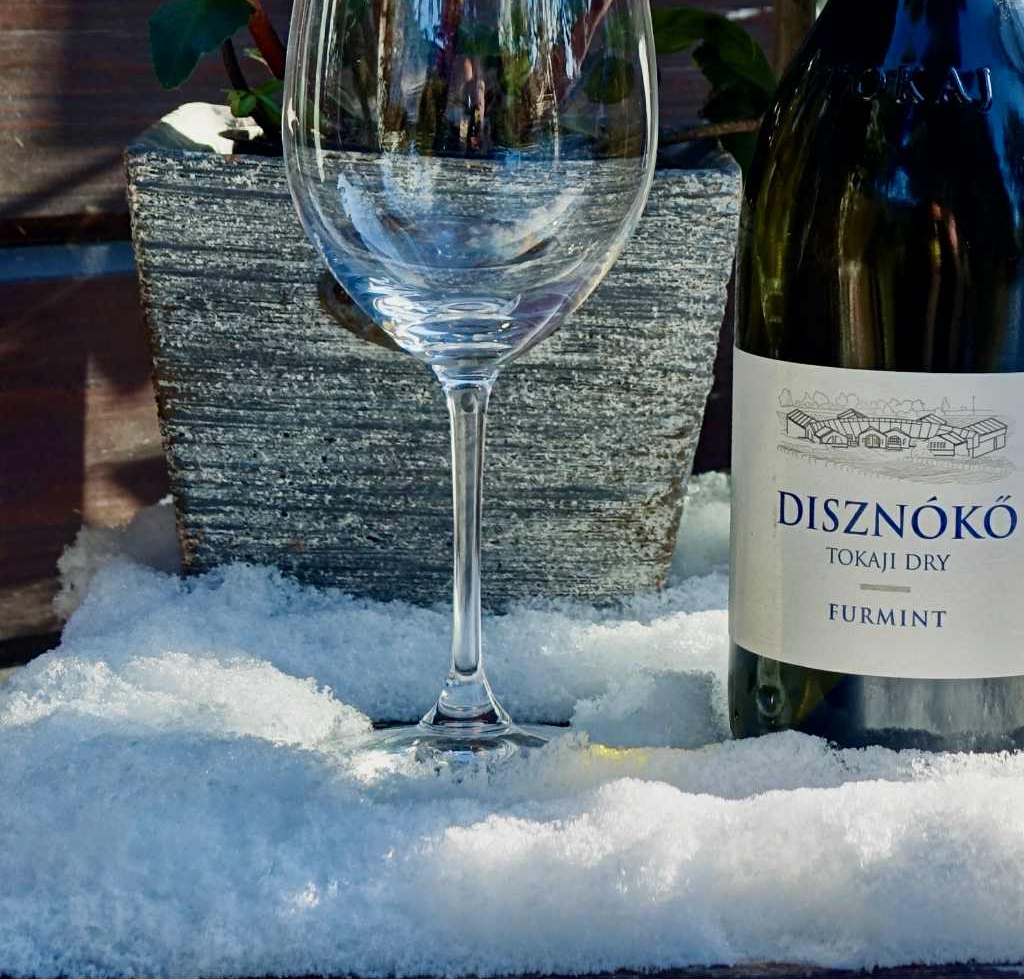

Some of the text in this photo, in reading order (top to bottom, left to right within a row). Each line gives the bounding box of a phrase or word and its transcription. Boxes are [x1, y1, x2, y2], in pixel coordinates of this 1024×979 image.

[776, 489, 1018, 540] DISZNÓKŐ
[826, 547, 951, 573] TOKAJI DRY
[829, 603, 947, 627] FURMINT
